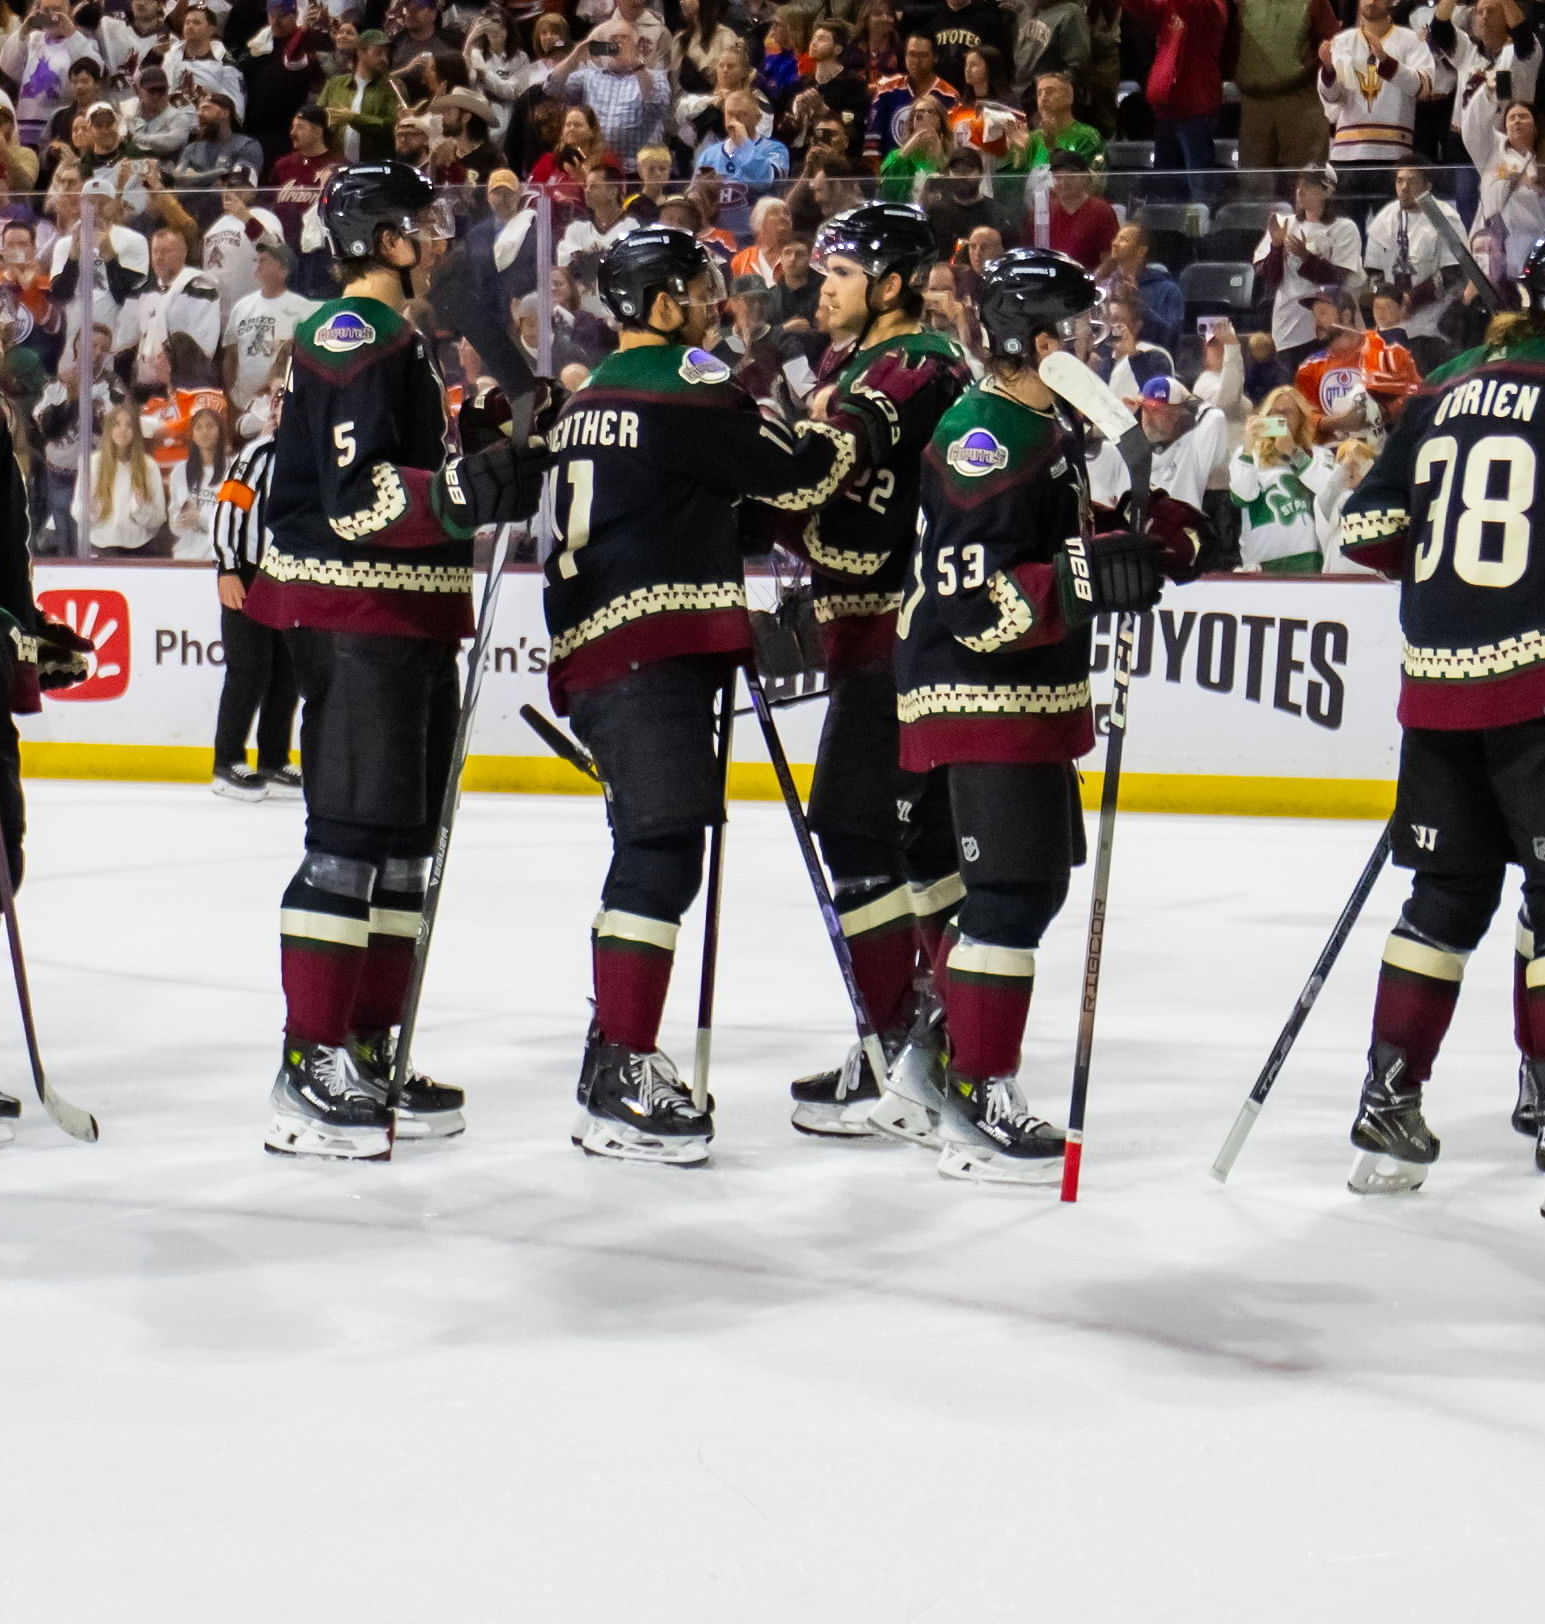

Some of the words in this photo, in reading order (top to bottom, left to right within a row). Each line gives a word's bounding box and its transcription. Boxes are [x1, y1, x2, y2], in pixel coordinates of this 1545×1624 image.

[333, 421, 357, 468] 5
[1414, 435, 1537, 589] 38
[937, 543, 985, 597] 53
